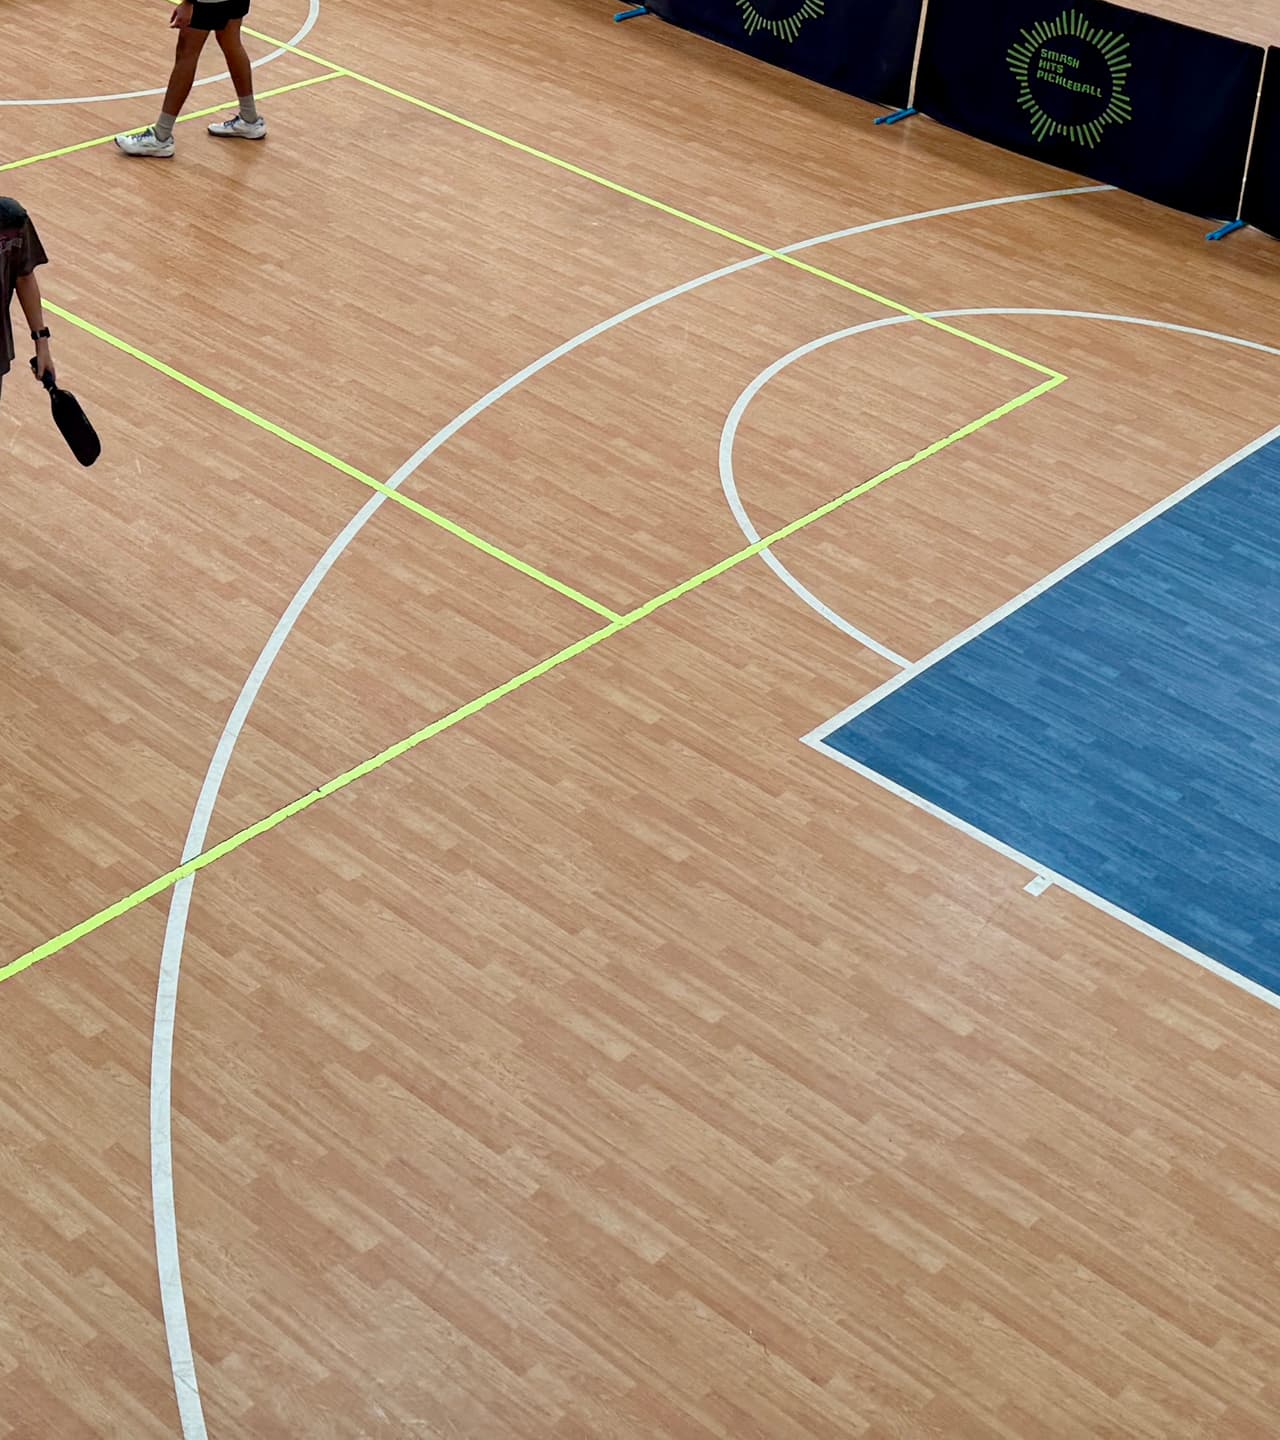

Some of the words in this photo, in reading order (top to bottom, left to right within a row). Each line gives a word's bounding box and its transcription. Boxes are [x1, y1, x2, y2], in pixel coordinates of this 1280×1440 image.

[1038, 59, 1064, 74] HITS
[1040, 48, 1080, 69] SMASH
[1036, 69, 1103, 98] PICKLEBALL
